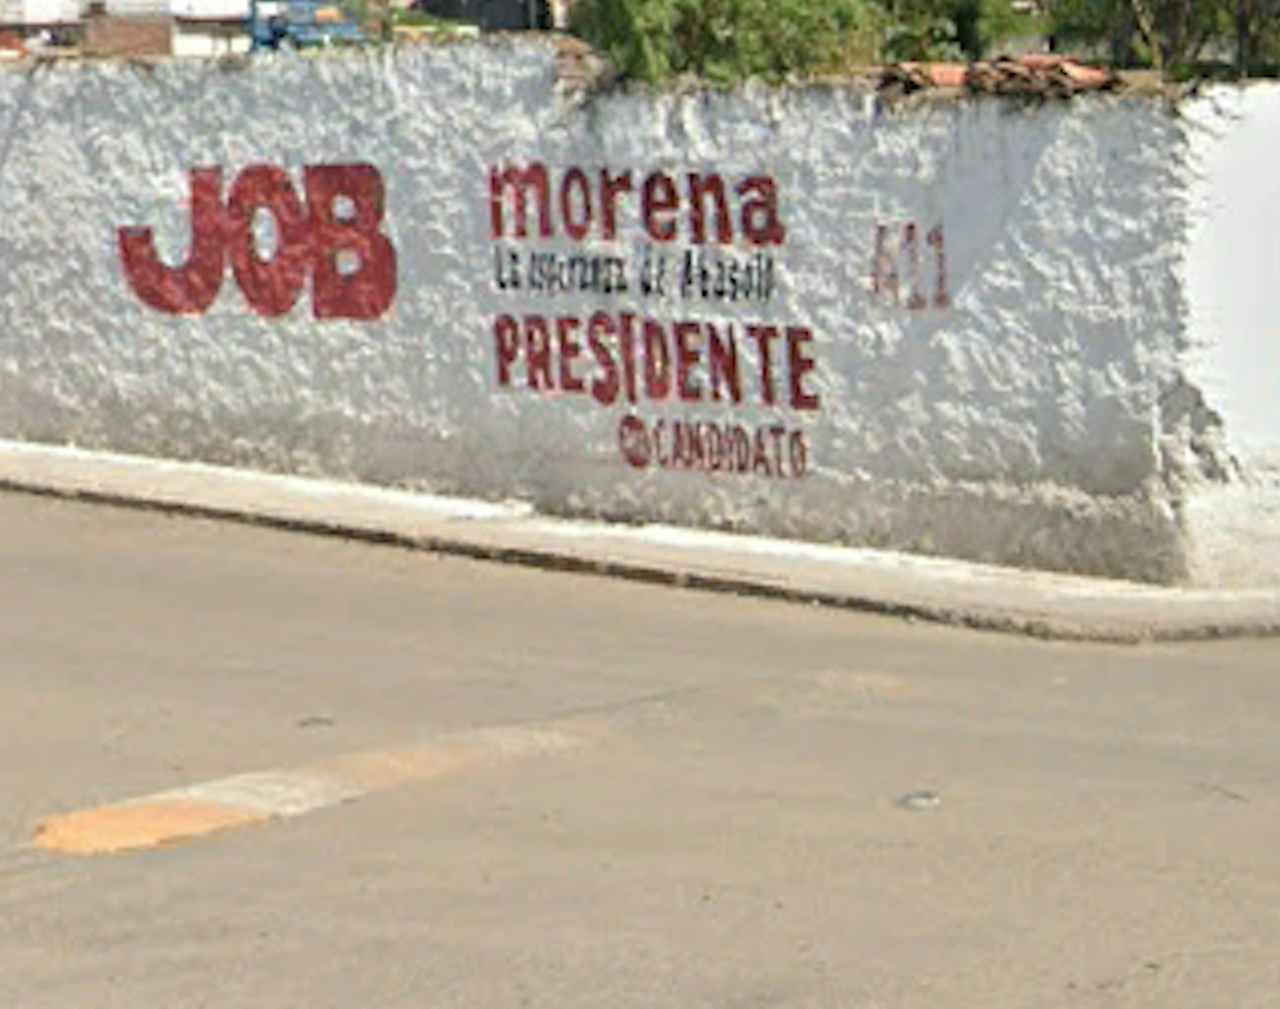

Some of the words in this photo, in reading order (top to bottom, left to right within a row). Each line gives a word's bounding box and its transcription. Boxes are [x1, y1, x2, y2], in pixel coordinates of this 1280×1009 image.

[120, 161, 397, 322] JOB
[490, 161, 786, 246] morena
[493, 310, 820, 410] PRESIDENTE
[653, 417, 807, 478] CANDIDATO
